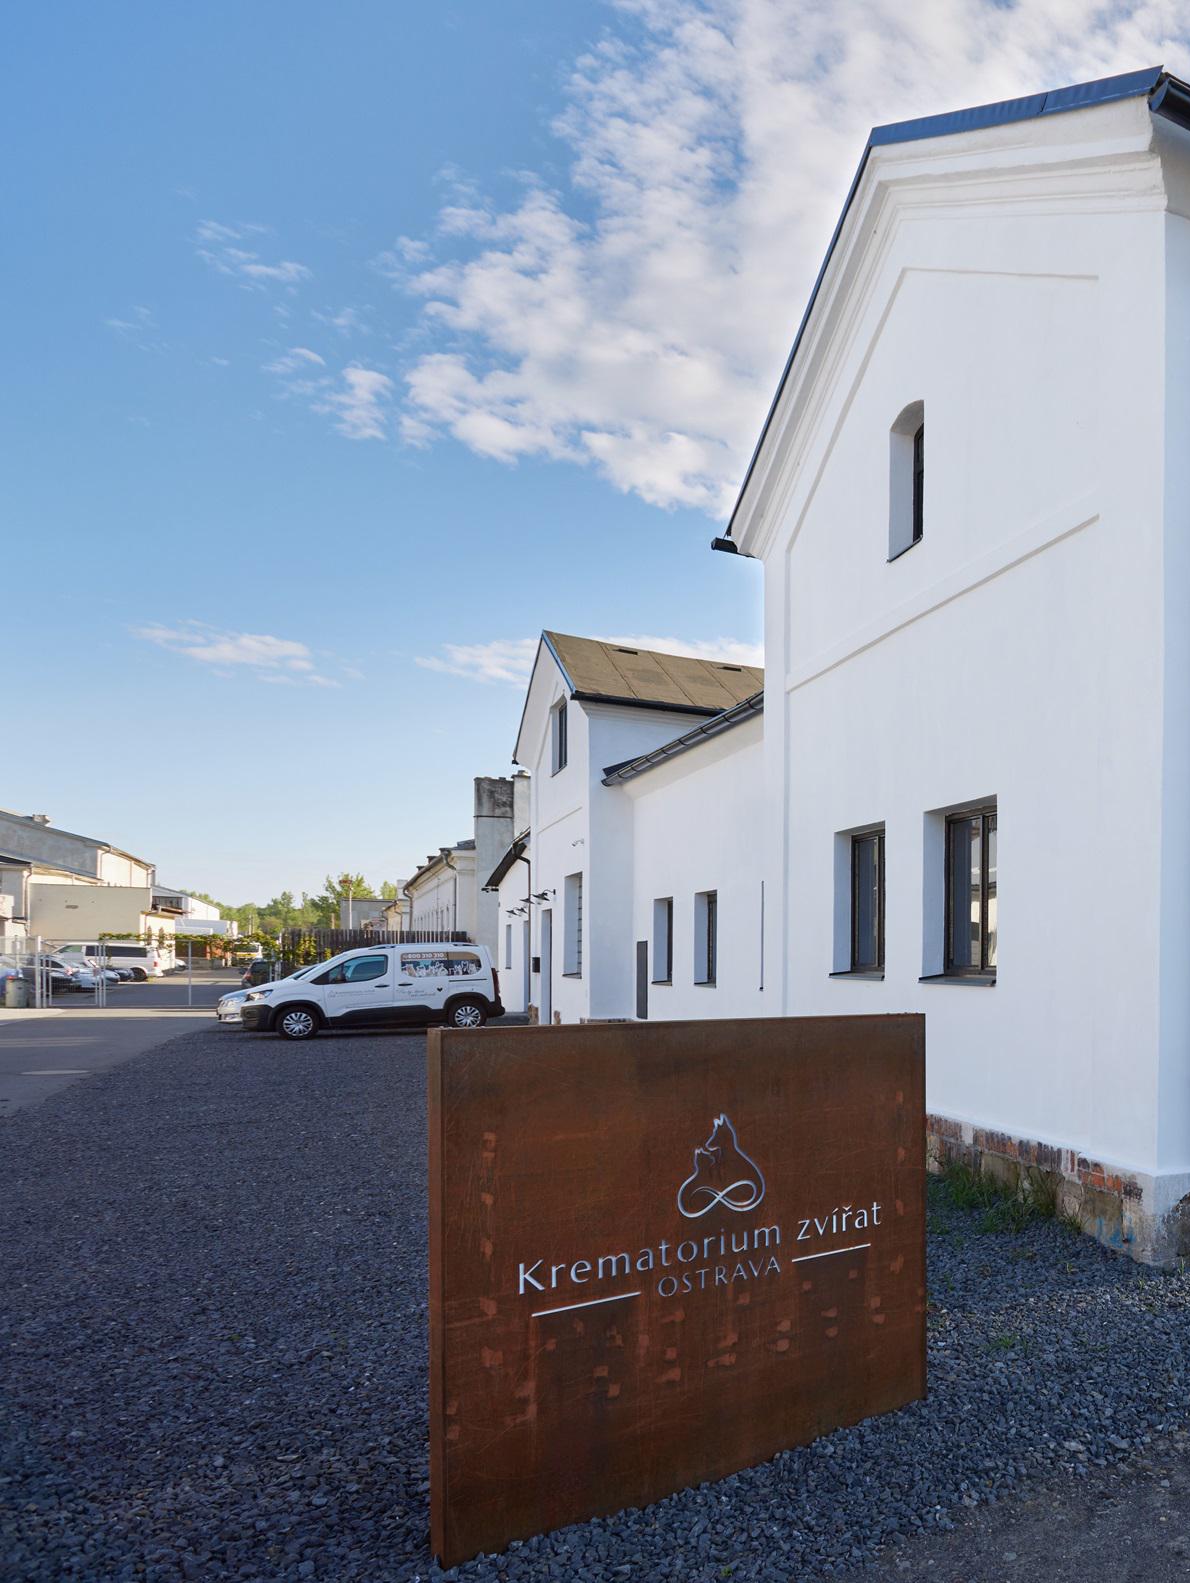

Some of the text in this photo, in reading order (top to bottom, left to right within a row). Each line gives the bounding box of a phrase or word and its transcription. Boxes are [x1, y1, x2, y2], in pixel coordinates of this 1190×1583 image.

[518, 1202, 882, 1295] Krematorium zvířat
[657, 1256, 781, 1297] OSTRAVA
